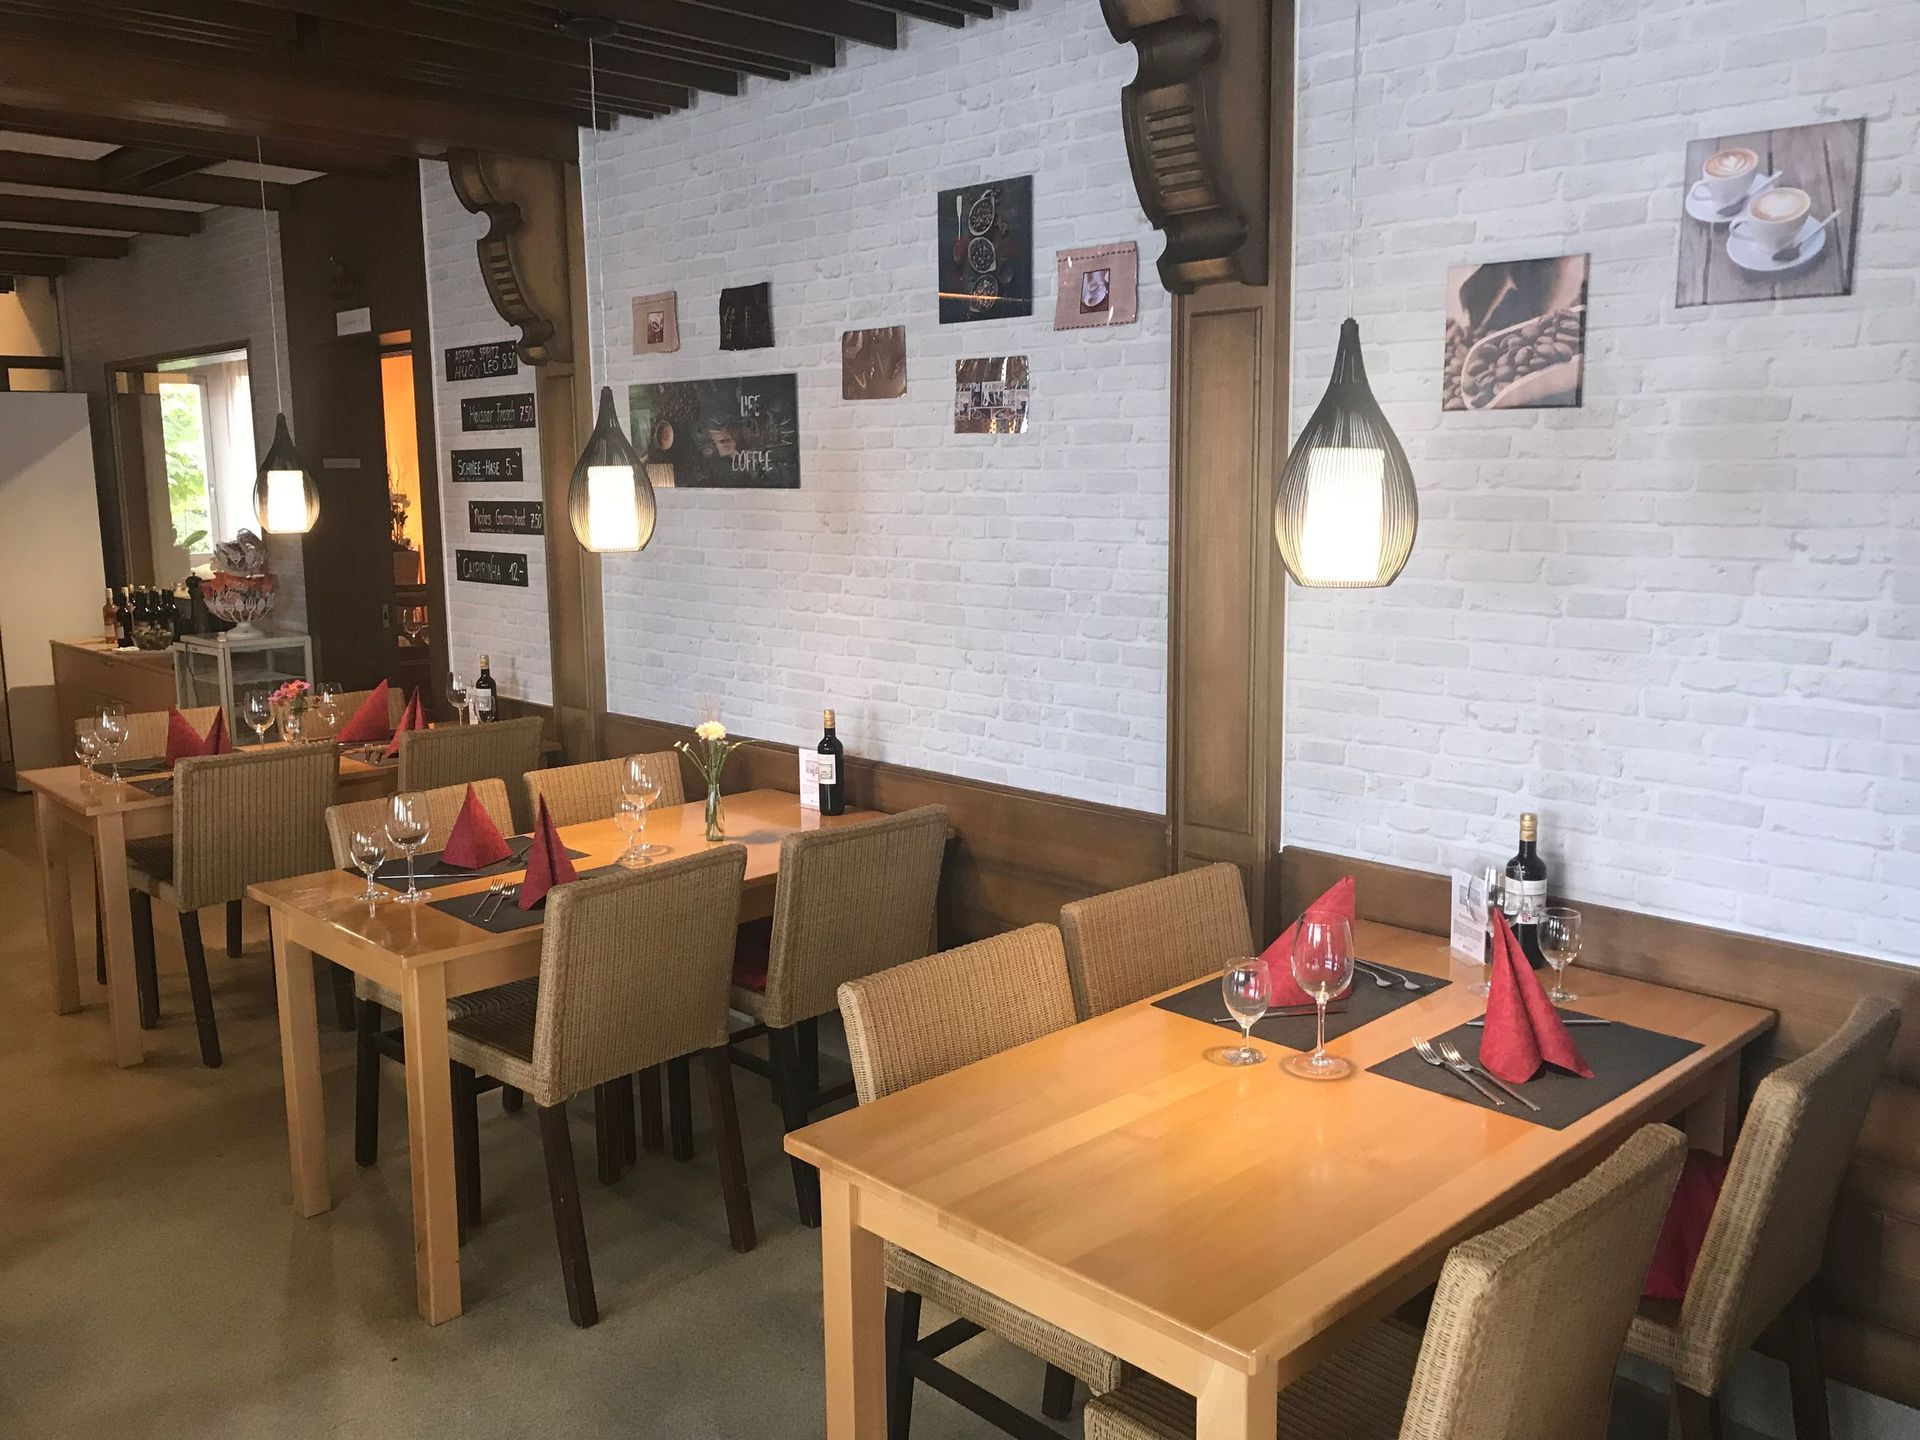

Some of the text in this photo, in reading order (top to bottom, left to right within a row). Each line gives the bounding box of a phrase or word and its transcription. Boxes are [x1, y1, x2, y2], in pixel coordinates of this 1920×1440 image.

[480, 345, 500, 361] SPRITZ
[454, 365, 480, 379] HUGO
[483, 360, 499, 374] LEO
[740, 395, 761, 417] LIFE
[732, 450, 773, 472] COFFEE
